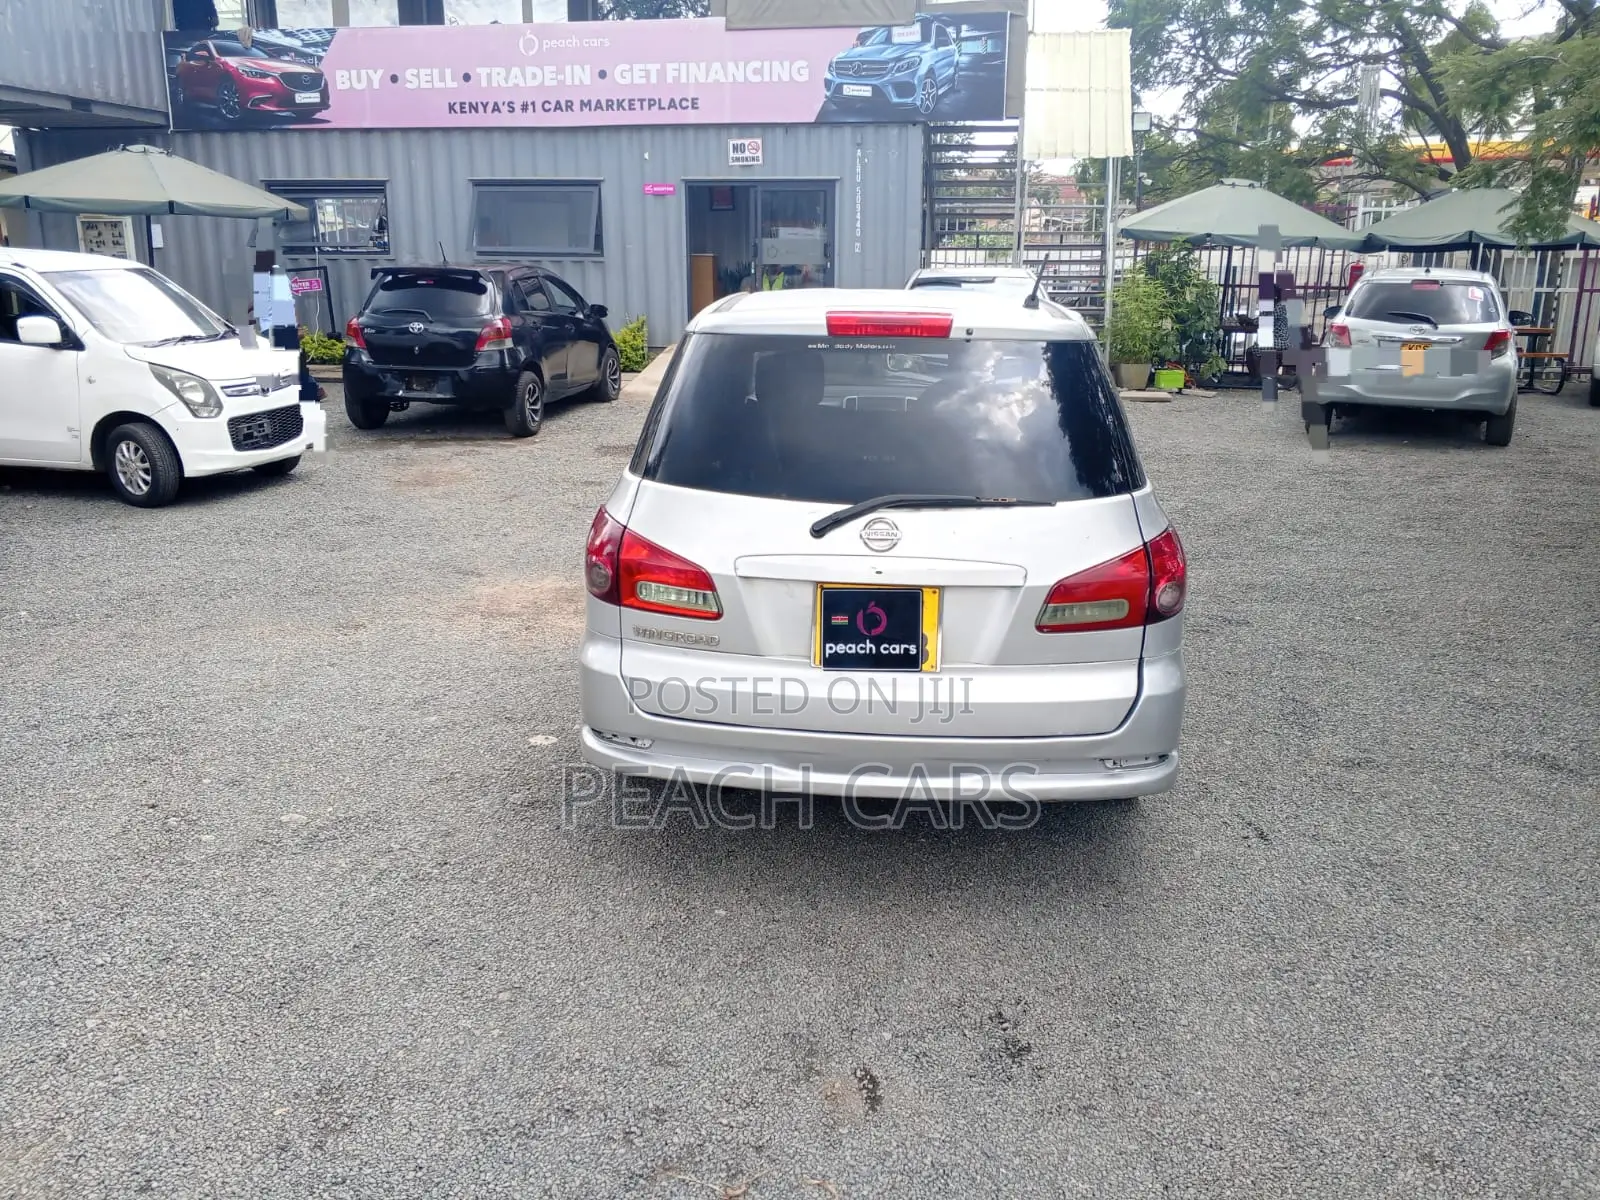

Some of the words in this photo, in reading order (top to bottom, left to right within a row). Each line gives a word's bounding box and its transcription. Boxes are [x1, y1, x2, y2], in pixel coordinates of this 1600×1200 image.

[542, 36, 580, 52] peach
[582, 37, 610, 48] cars
[335, 69, 384, 90] BUY
[404, 68, 458, 89] SELL
[475, 64, 592, 88] TRADE-IN
[613, 63, 661, 85] GET
[666, 60, 810, 84] FINANCING
[448, 101, 516, 115] KENYA'S
[520, 100, 536, 114] #1
[541, 99, 574, 113] CAR
[579, 97, 700, 113] MARKETPLACE
[732, 142, 746, 154] NO
[731, 155, 760, 163] SMOKING
[825, 639, 876, 658] peach
[880, 643, 917, 655] cars
